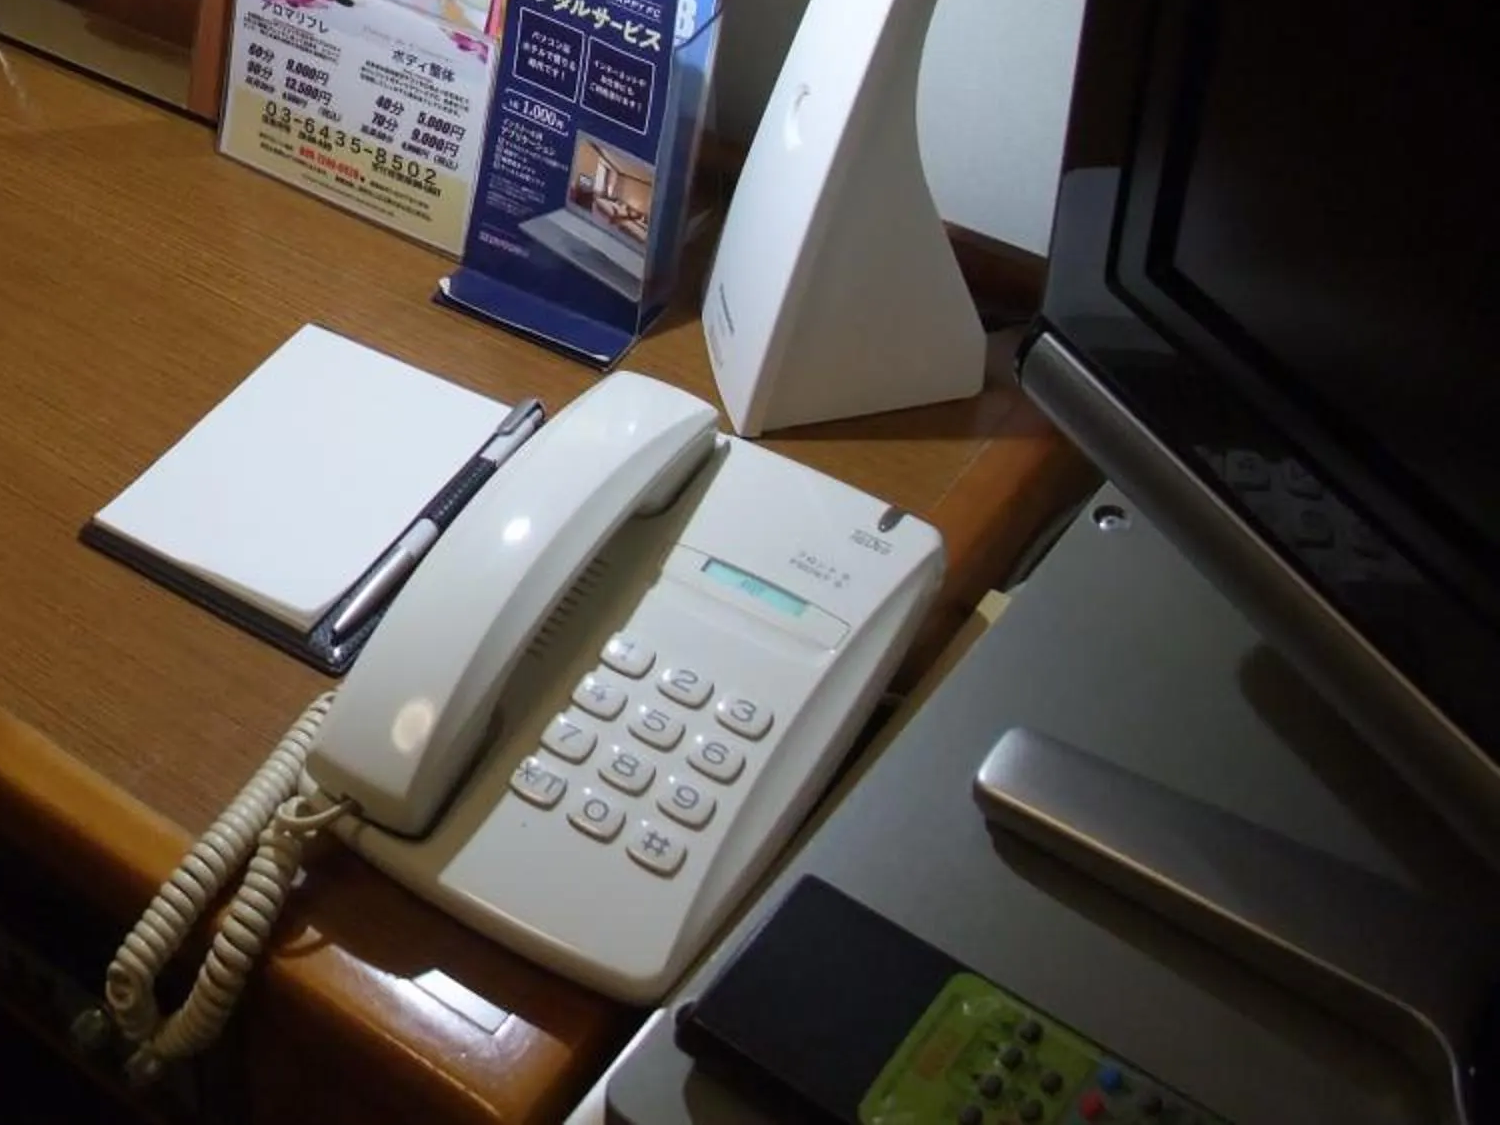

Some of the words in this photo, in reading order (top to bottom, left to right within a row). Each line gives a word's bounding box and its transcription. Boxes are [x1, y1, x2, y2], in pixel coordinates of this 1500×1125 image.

[265, 100, 437, 185] 03-6435-8502
[671, 669, 699, 693] 2
[642, 709, 671, 733] 5
[729, 699, 757, 723] 3
[558, 723, 583, 743] 7
[611, 752, 640, 777] 8
[701, 741, 730, 766] 6
[672, 784, 700, 810] 9
[582, 798, 610, 823] 0
